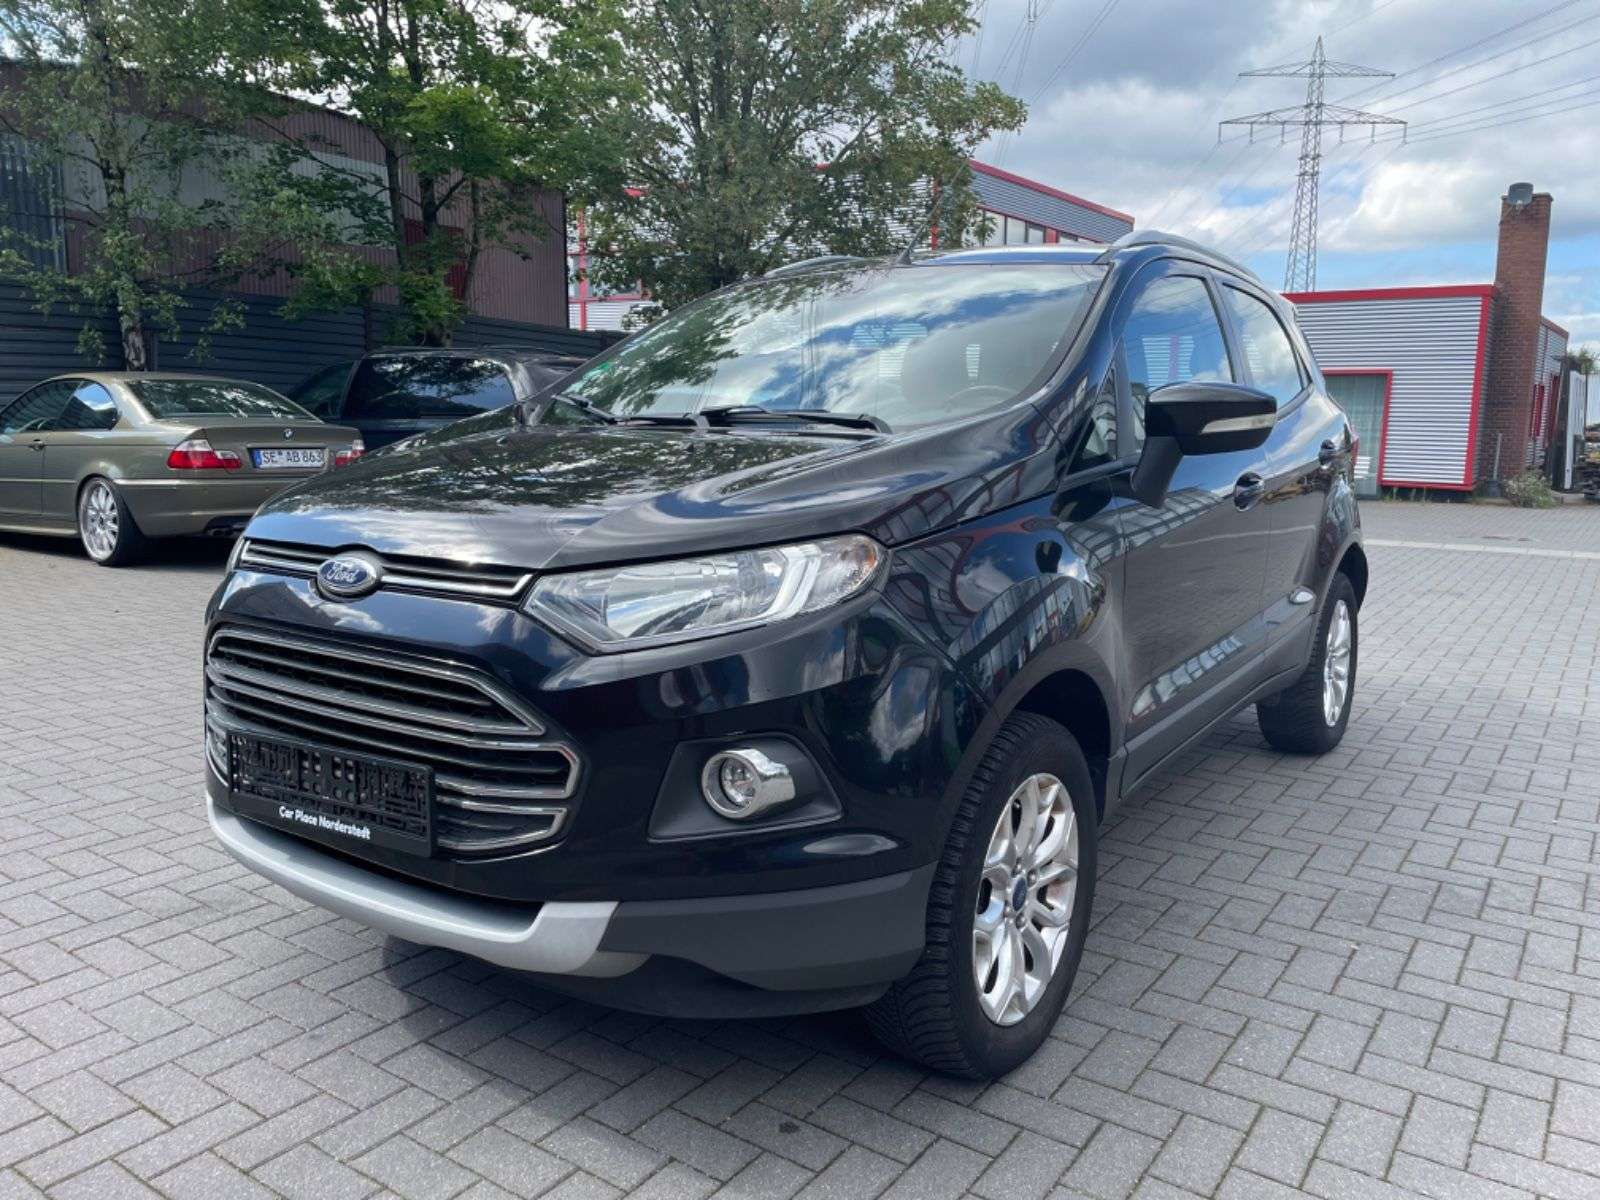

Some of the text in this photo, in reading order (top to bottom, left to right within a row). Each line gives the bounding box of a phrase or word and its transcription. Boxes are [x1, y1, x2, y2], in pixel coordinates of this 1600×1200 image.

[263, 451, 278, 463] SE
[286, 451, 300, 463] AB
[326, 561, 360, 583] Ford
[279, 805, 371, 840] Car Place Norderstedt
